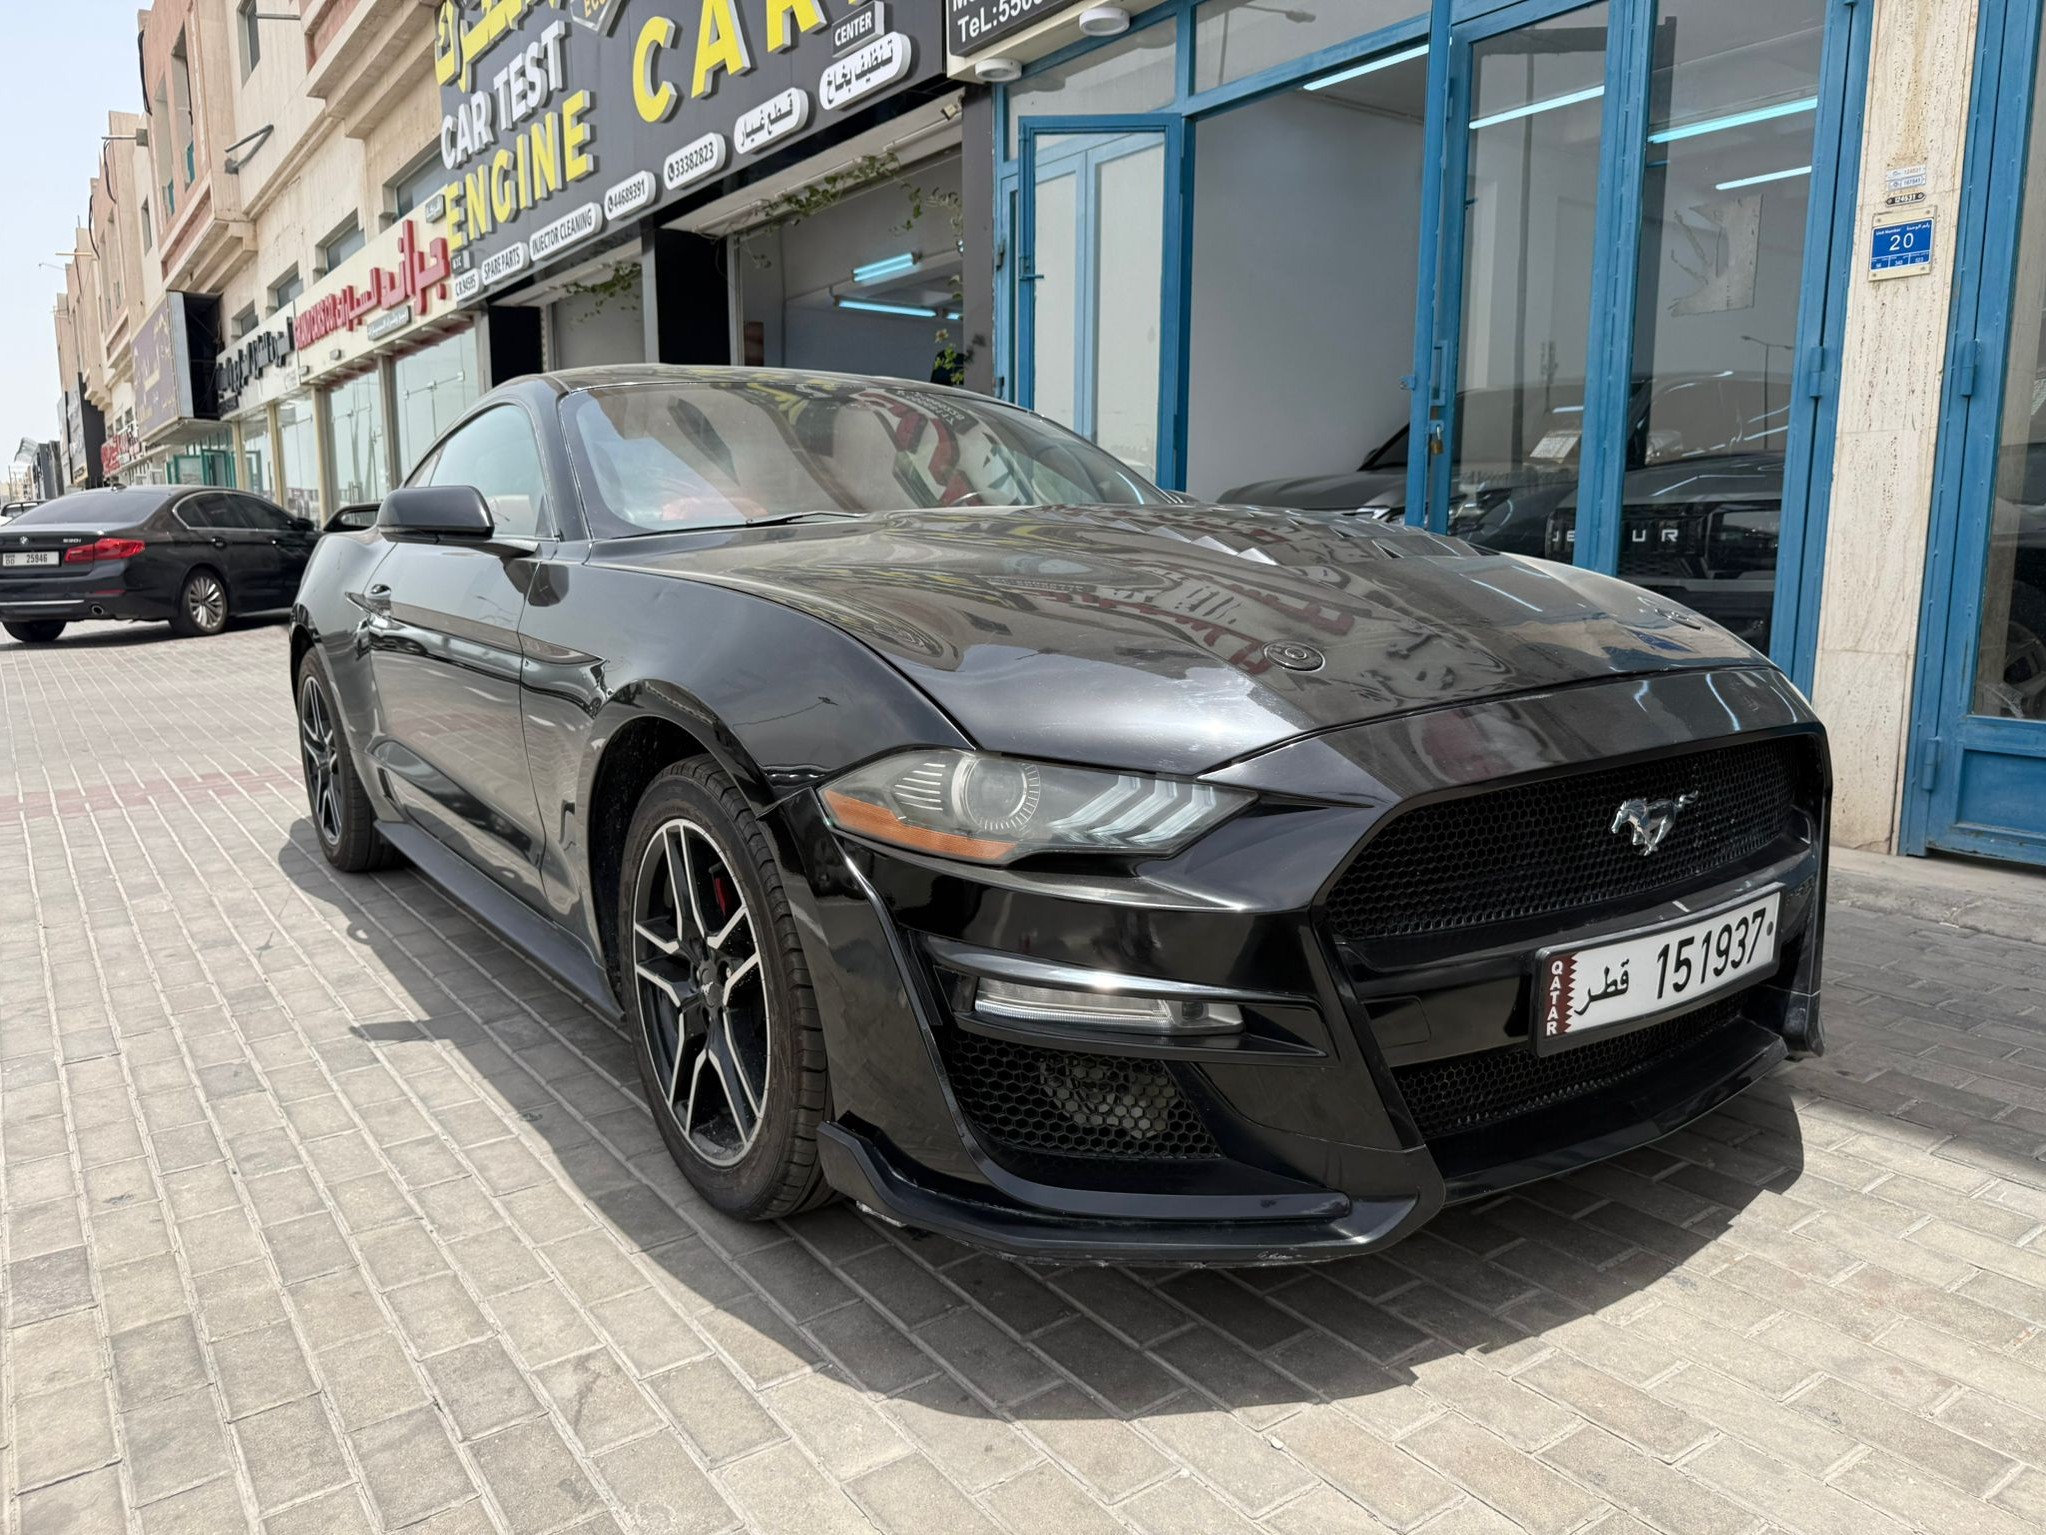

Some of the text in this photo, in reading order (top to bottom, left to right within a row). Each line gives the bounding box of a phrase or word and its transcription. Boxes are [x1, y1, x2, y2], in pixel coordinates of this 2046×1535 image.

[834, 11, 872, 46] CENTER
[441, 20, 562, 170] CAR TEST
[444, 89, 590, 250] ENGINE
[674, 142, 714, 178] 33382823
[533, 208, 592, 255] INJECTOR CLEANING
[1889, 232, 1914, 251] 20
[484, 256, 501, 280] SPARE
[501, 247, 521, 269] PARTS
[1656, 907, 1767, 1000] 151937
[1546, 960, 1563, 1036] QATAR
[1574, 958, 1630, 1016] قطر
